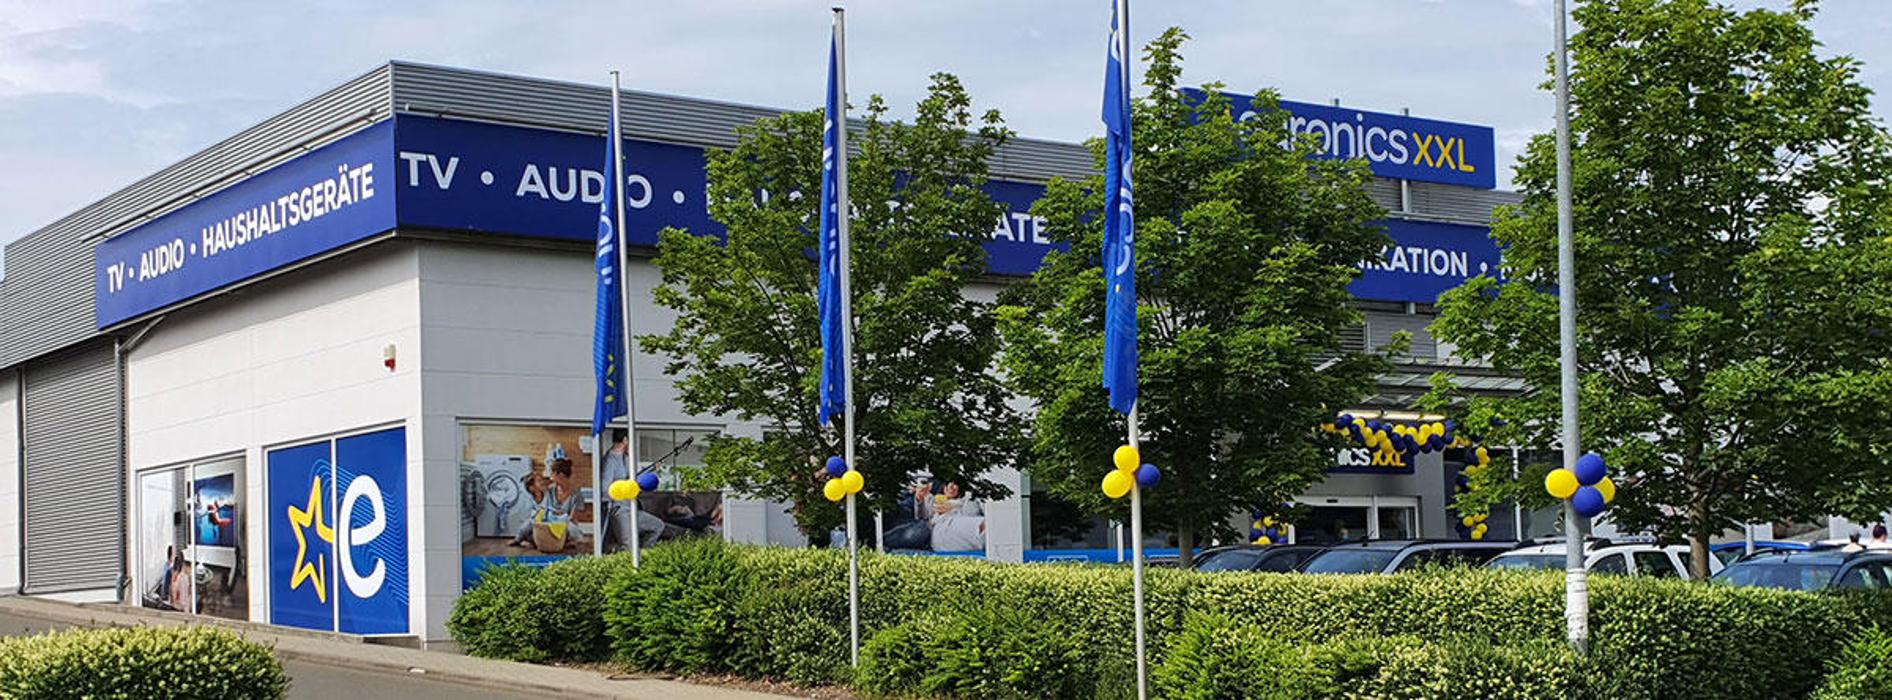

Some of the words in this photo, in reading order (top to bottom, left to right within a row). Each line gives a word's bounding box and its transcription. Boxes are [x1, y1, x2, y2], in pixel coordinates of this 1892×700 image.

[400, 152, 460, 190] TV
[516, 164, 653, 209] AUDO
[1412, 132, 1476, 174] XXL
[107, 261, 124, 295] TV
[138, 238, 185, 283] AUDIO
[202, 163, 375, 258] HAUSHALTSGERÄTE
